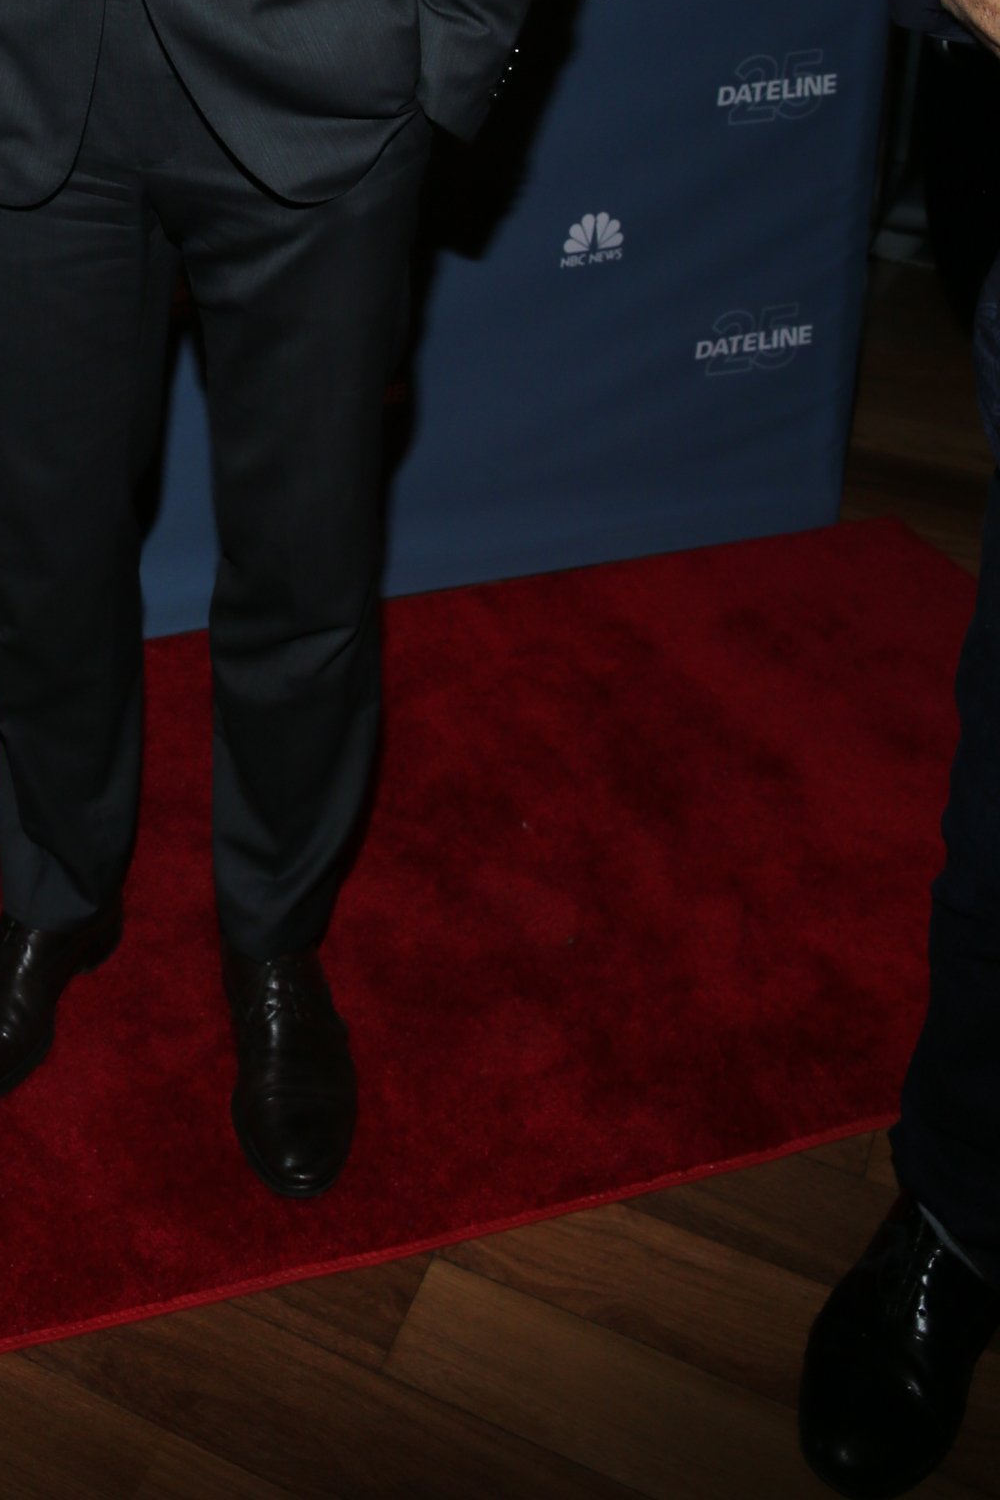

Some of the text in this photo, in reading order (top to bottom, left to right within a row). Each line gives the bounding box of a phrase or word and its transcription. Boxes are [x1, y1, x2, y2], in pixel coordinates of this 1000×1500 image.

[717, 73, 837, 107] DATELINE
[560, 249, 623, 269] NBC NEWS
[695, 325, 813, 360] DATELINE
